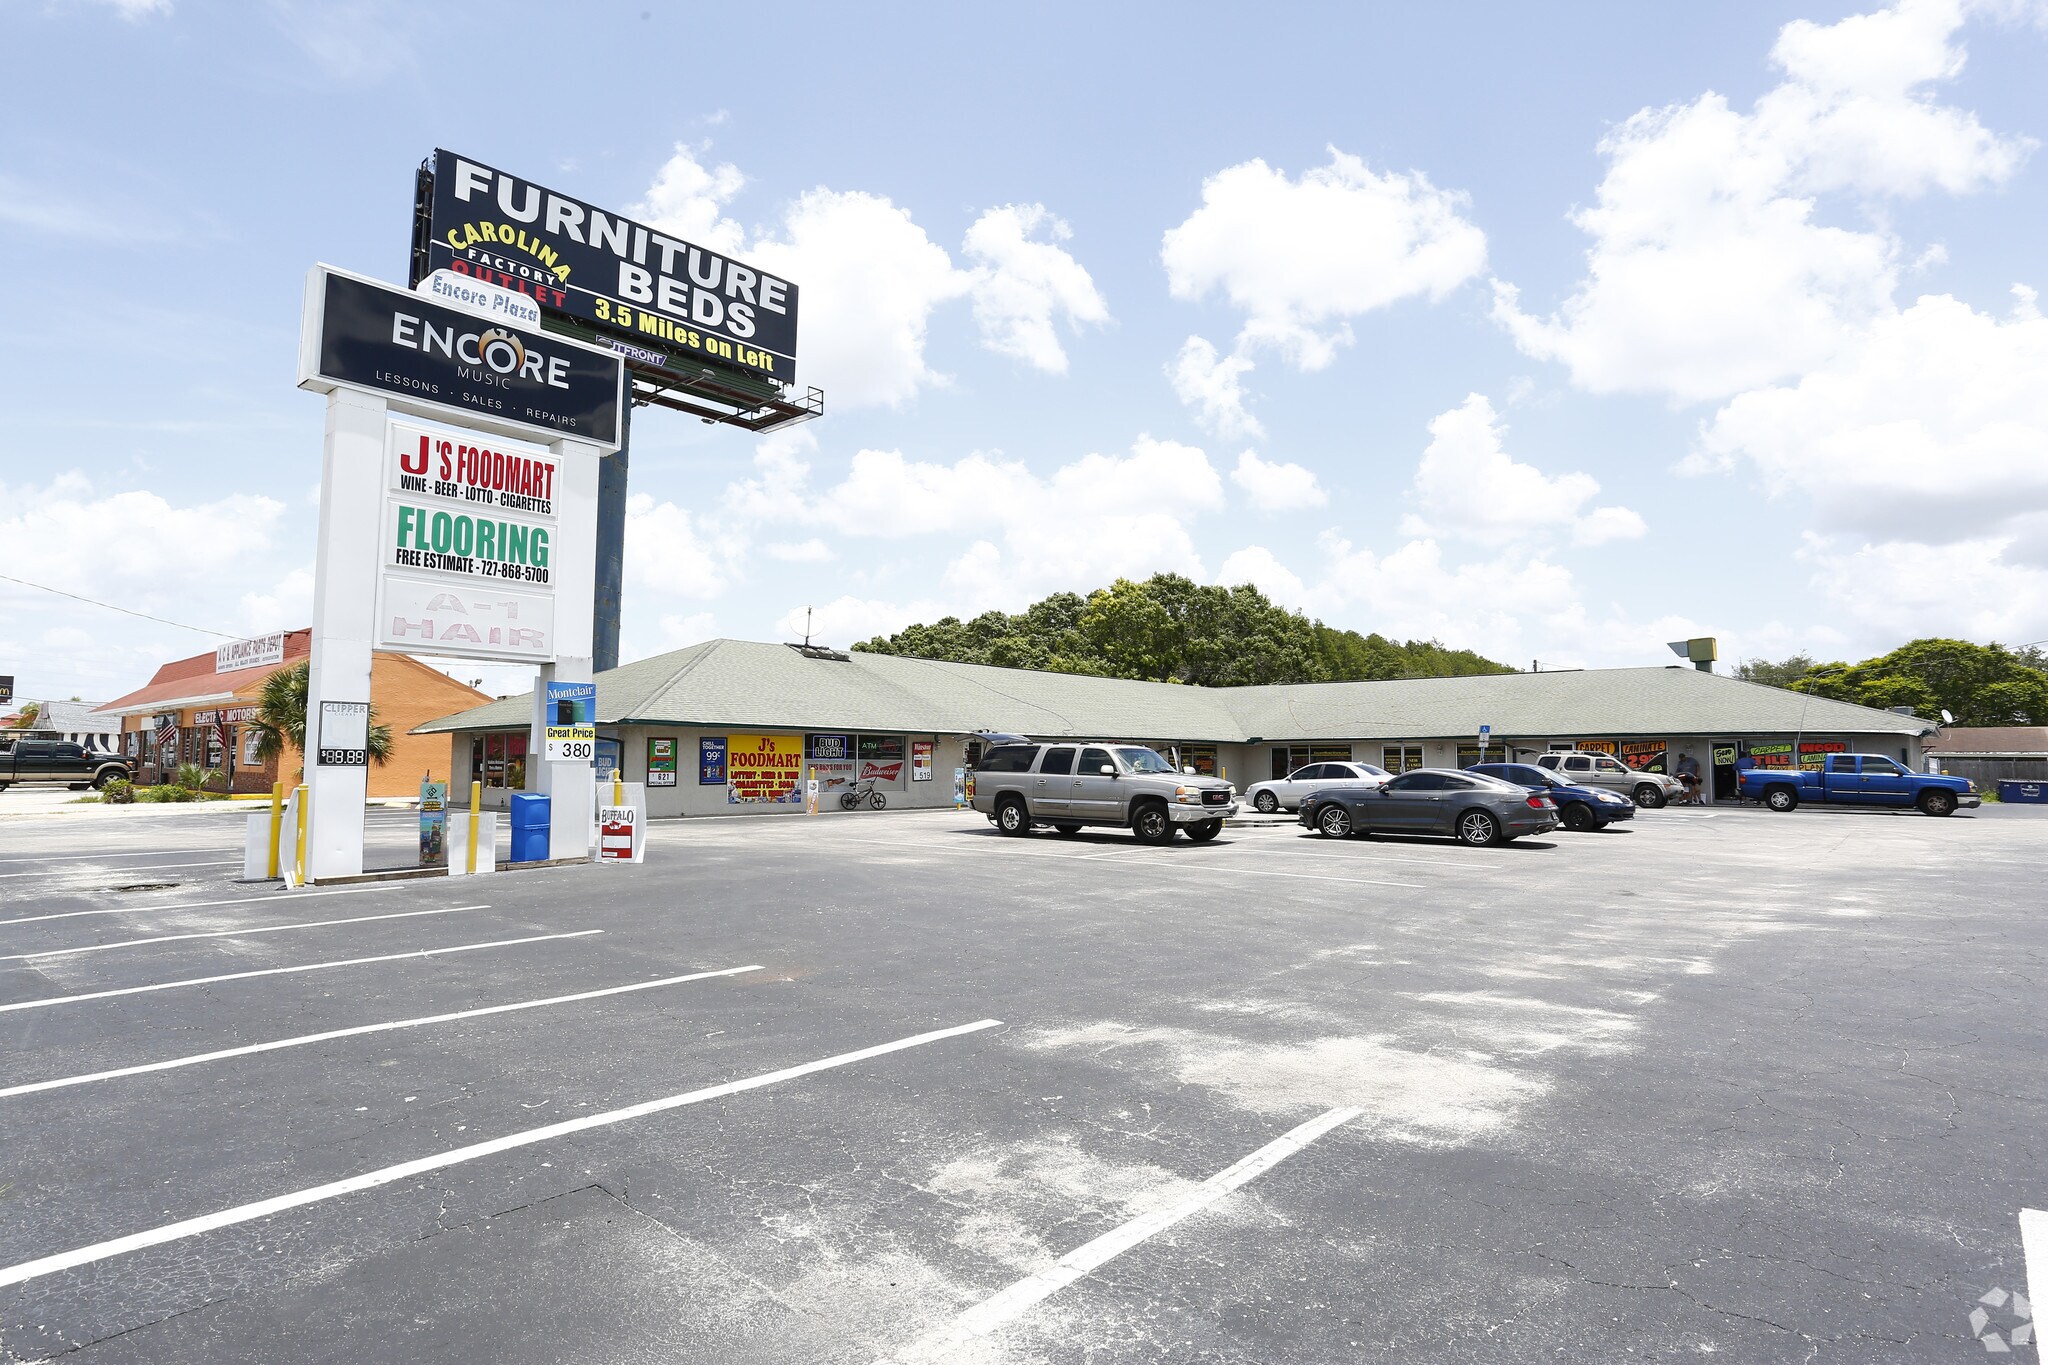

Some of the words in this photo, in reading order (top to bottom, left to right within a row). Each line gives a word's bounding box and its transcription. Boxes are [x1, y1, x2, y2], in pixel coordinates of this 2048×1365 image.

[455, 159, 788, 315] FURNITURE
[447, 221, 572, 283] CAROLINA
[468, 248, 559, 286] FACTORY
[452, 260, 566, 308] OUTLET
[432, 275, 487, 307] Encore
[492, 293, 538, 322] Plaza
[618, 261, 756, 338] BEDS
[595, 298, 632, 327] 3.5
[638, 312, 701, 349] Miles
[705, 337, 732, 360] on
[737, 344, 774, 372] Left
[392, 311, 571, 390] ENCORE
[457, 366, 511, 390] MUSIC
[375, 370, 440, 394] LESSONS
[462, 392, 502, 410] SALES
[526, 407, 577, 427] REPAIRS
[456, 444, 555, 500] FOODMART
[400, 474, 427, 493] WINE
[434, 480, 458, 498] BEER
[465, 485, 493, 504] LOTTO
[500, 492, 552, 515] CIGARETTES
[397, 505, 549, 568] FLOORING
[396, 548, 421, 567] FREE
[423, 551, 474, 574] ESTIMATE
[481, 560, 549, 584] 727-868-5700
[425, 593, 518, 619] A-1
[392, 616, 545, 648] HAIR
[548, 686, 593, 700] Montclair
[195, 710, 223, 724] ELECTC
[227, 707, 257, 721] MOTORS
[324, 704, 366, 713] CLIPPER
[547, 727, 570, 739] Great
[572, 728, 594, 739] Price
[548, 743, 553, 751] $
[758, 737, 776, 752] J's
[819, 738, 841, 747] BUD
[862, 742, 877, 750] ATM
[1580, 742, 1611, 752] CARPET
[1624, 741, 1663, 753] LAMINATE
[1800, 743, 1845, 752] WOOD
[815, 746, 843, 757] LIGHT
[598, 758, 612, 766] BUD
[730, 752, 801, 768] FOODMART
[1752, 755, 1789, 765] TILE
[1798, 764, 1824, 772] PLAN
[595, 767, 613, 776] LIGH
[863, 766, 899, 776] Budweiser
[919, 771, 931, 780] 519
[601, 808, 634, 824] BUFFALO
